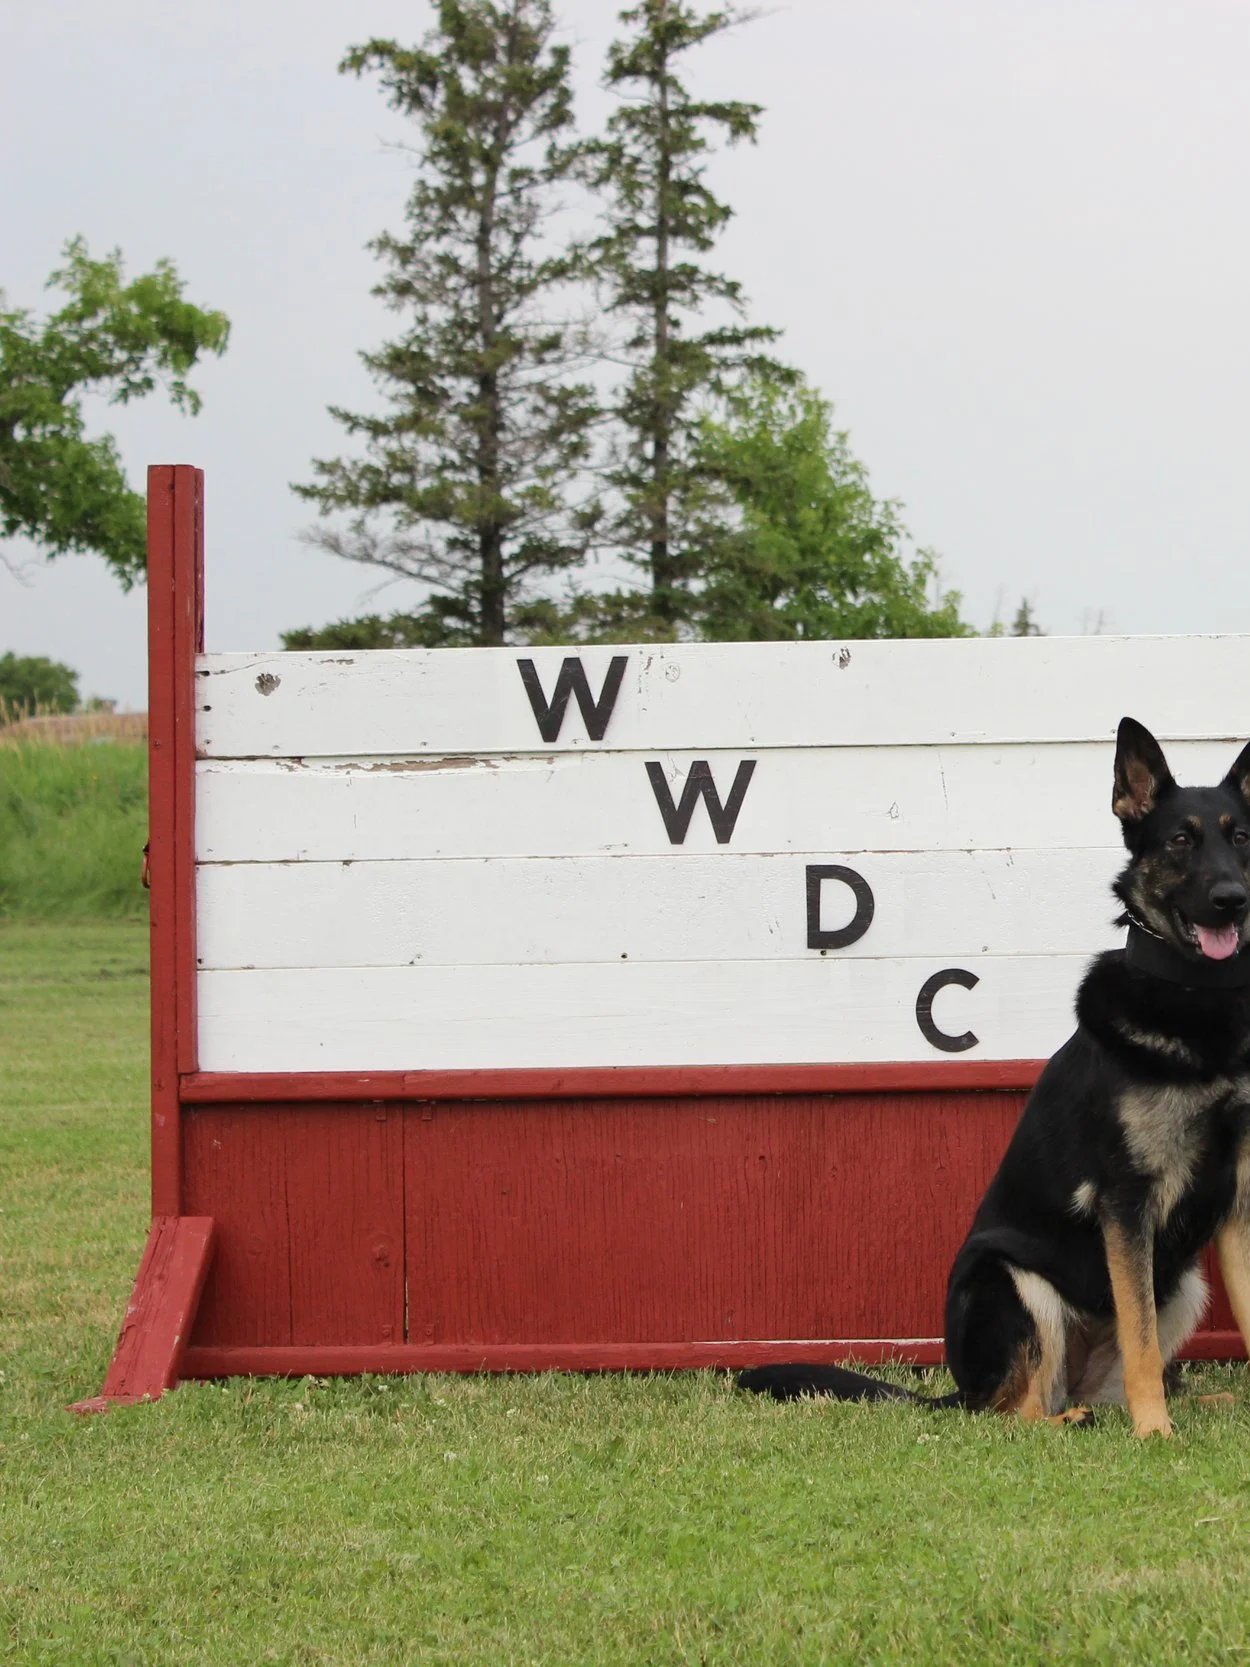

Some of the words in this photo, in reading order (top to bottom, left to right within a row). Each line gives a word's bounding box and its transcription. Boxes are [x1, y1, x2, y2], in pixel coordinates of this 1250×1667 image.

[516, 656, 629, 742] W
[644, 760, 757, 844] W
[805, 864, 875, 950] D
[915, 967, 980, 1053] C
